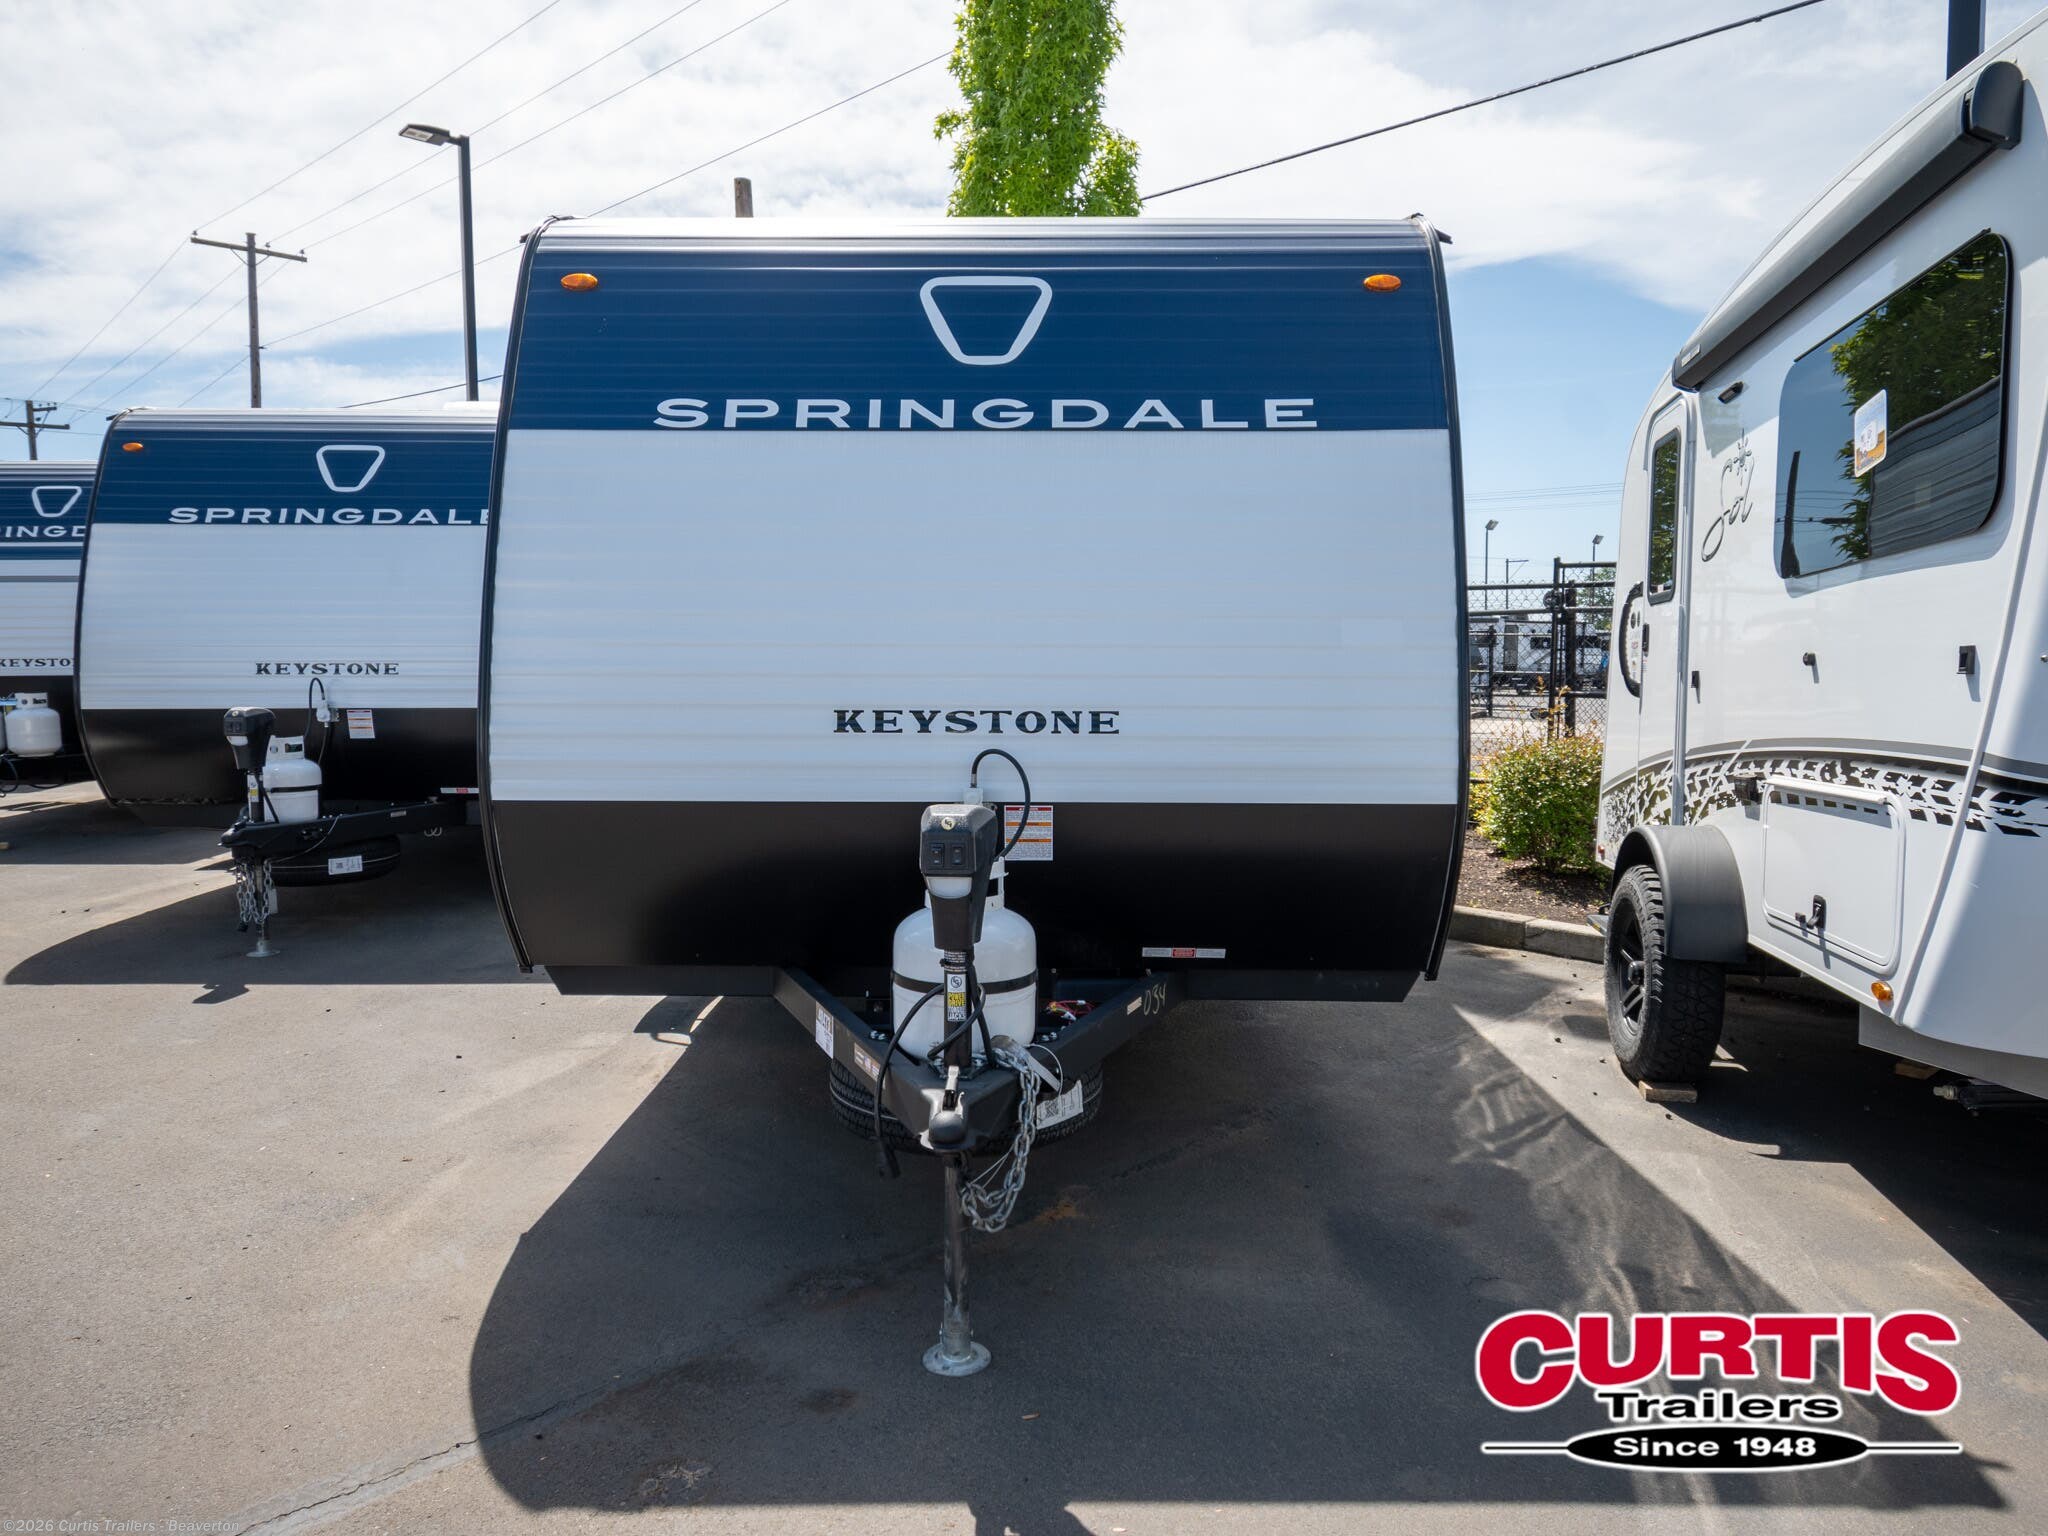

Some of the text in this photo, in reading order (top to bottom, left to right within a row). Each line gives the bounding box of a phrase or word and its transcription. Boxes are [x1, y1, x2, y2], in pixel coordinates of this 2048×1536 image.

[653, 397, 1318, 429] SPRINGDALE
[0, 525, 86, 538] INGD
[0, 657, 74, 668] KEYSTO
[255, 662, 400, 676] KEYSTONE
[833, 709, 1120, 735] KEYSTONE
